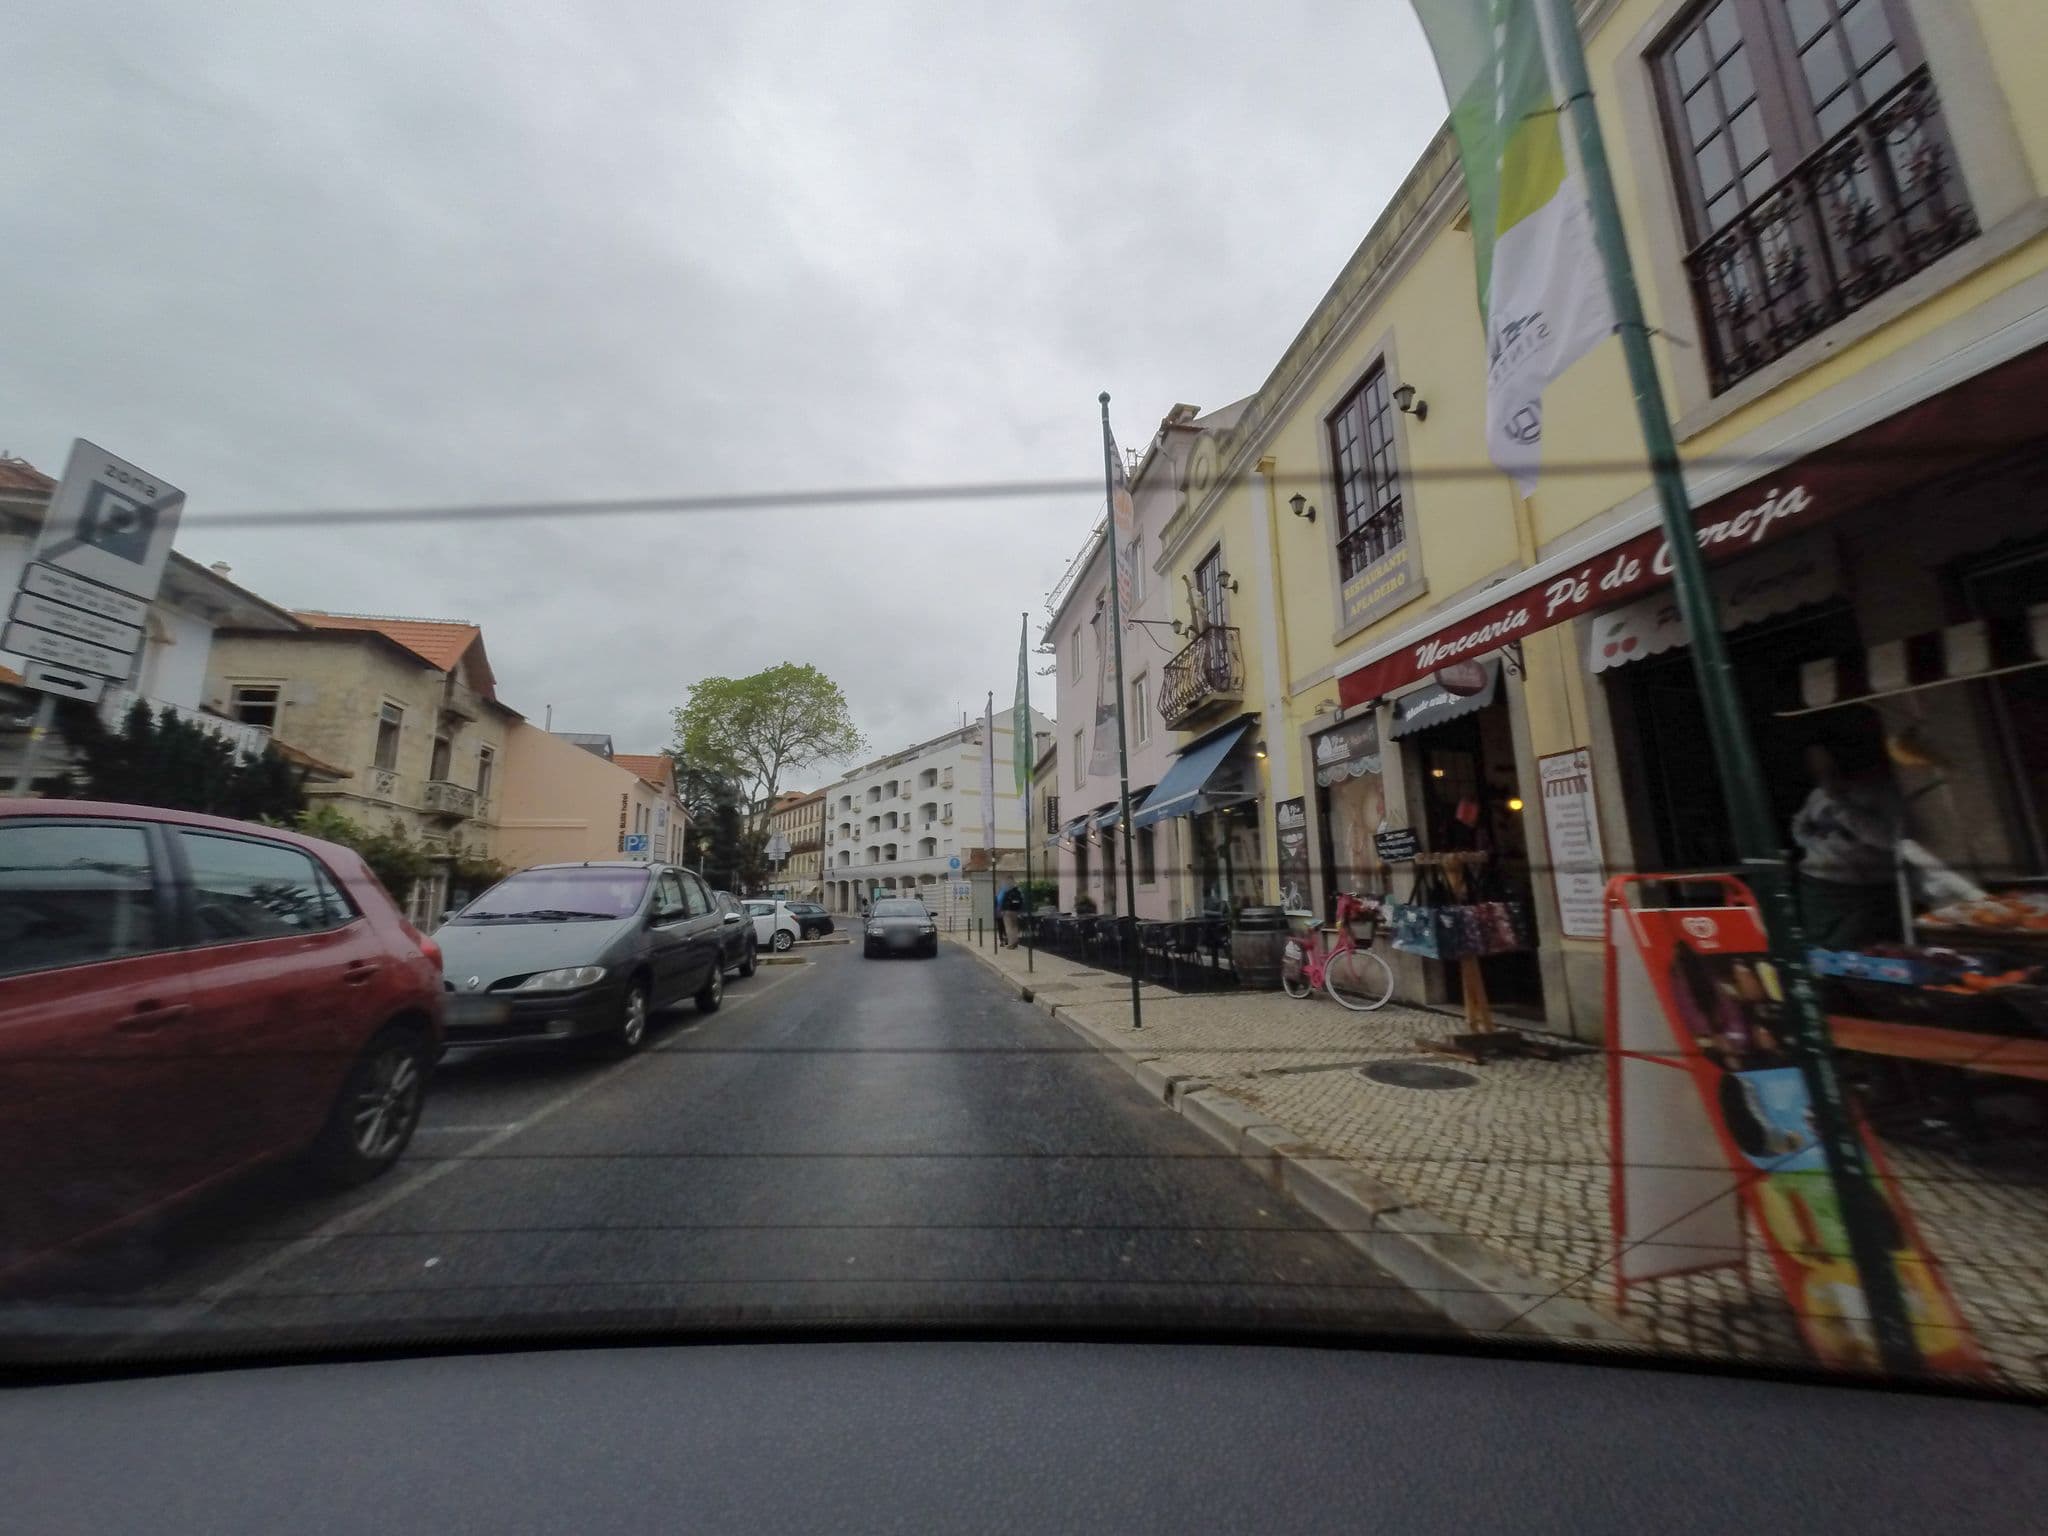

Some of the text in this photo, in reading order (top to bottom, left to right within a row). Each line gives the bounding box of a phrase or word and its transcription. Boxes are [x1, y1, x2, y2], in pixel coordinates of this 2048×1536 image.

[1416, 608, 1529, 669] Mercearia
[1545, 568, 1590, 617] Pé
[1600, 555, 1641, 590] de
[1653, 485, 1814, 575] Creja
